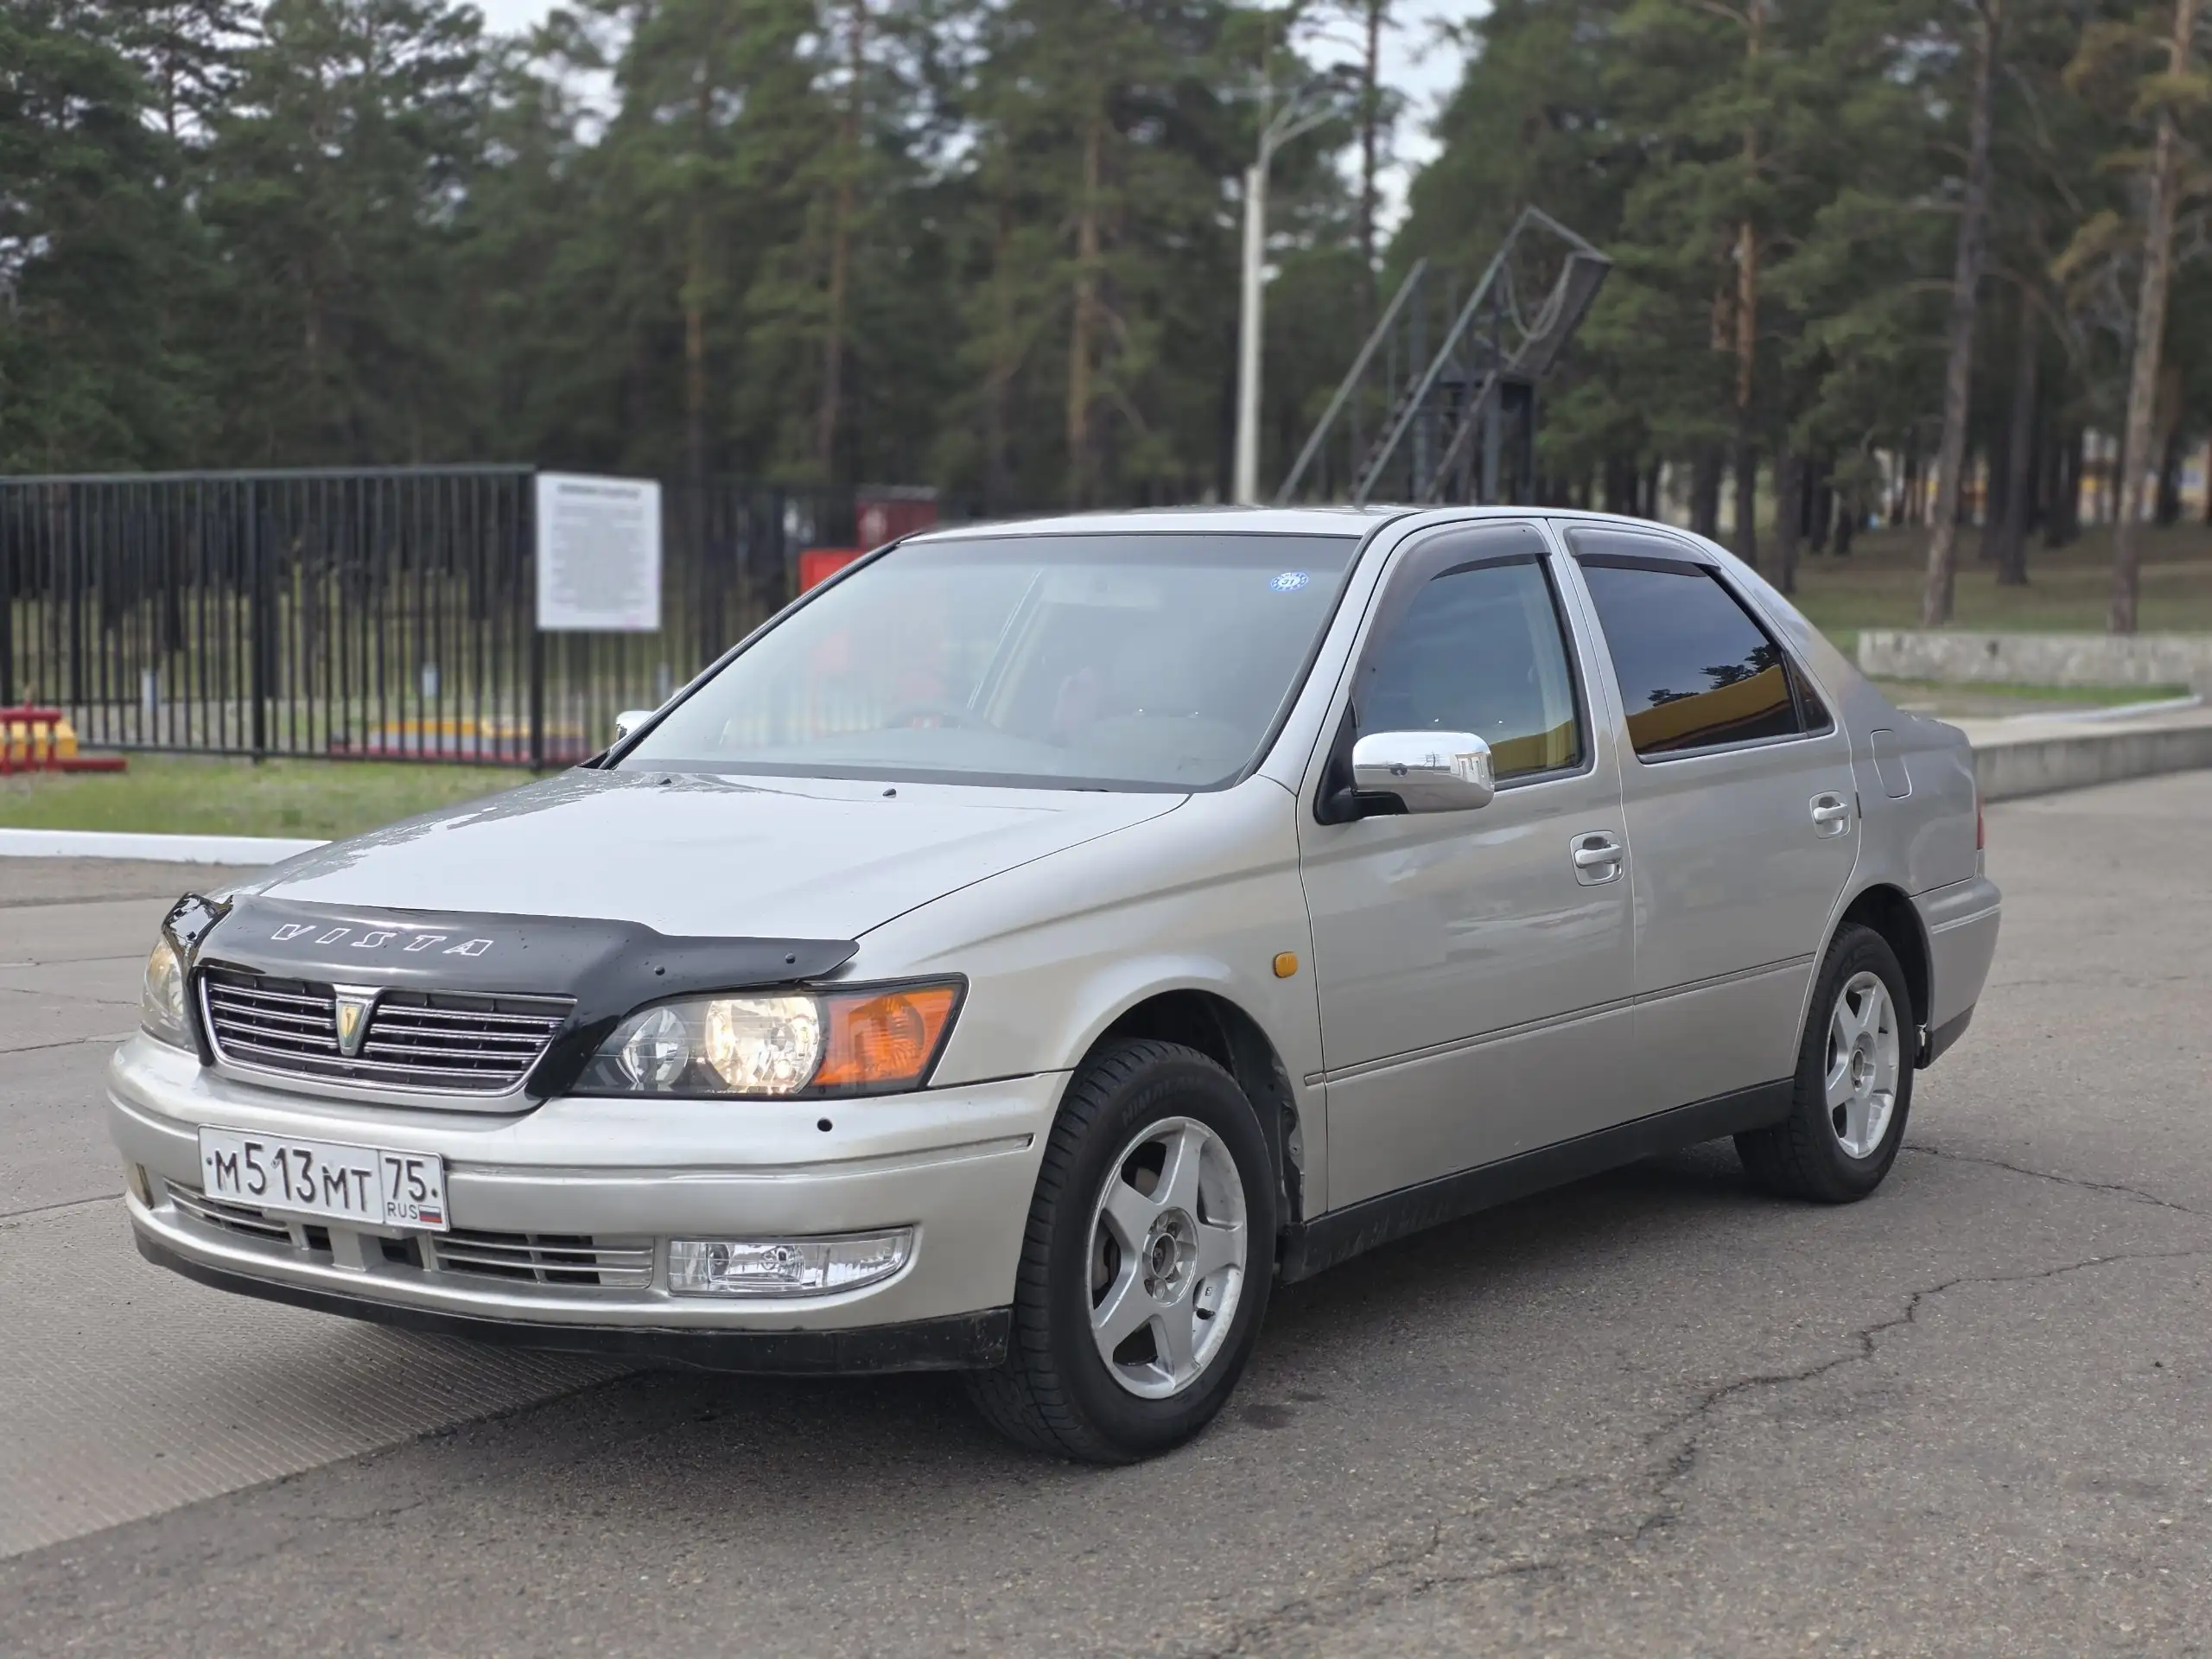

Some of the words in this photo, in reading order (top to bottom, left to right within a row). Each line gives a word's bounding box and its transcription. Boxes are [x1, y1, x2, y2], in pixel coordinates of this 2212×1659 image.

[270, 924, 494, 957] VISTA
[385, 1158, 427, 1202] 75
[387, 1202, 417, 1219] RUS
